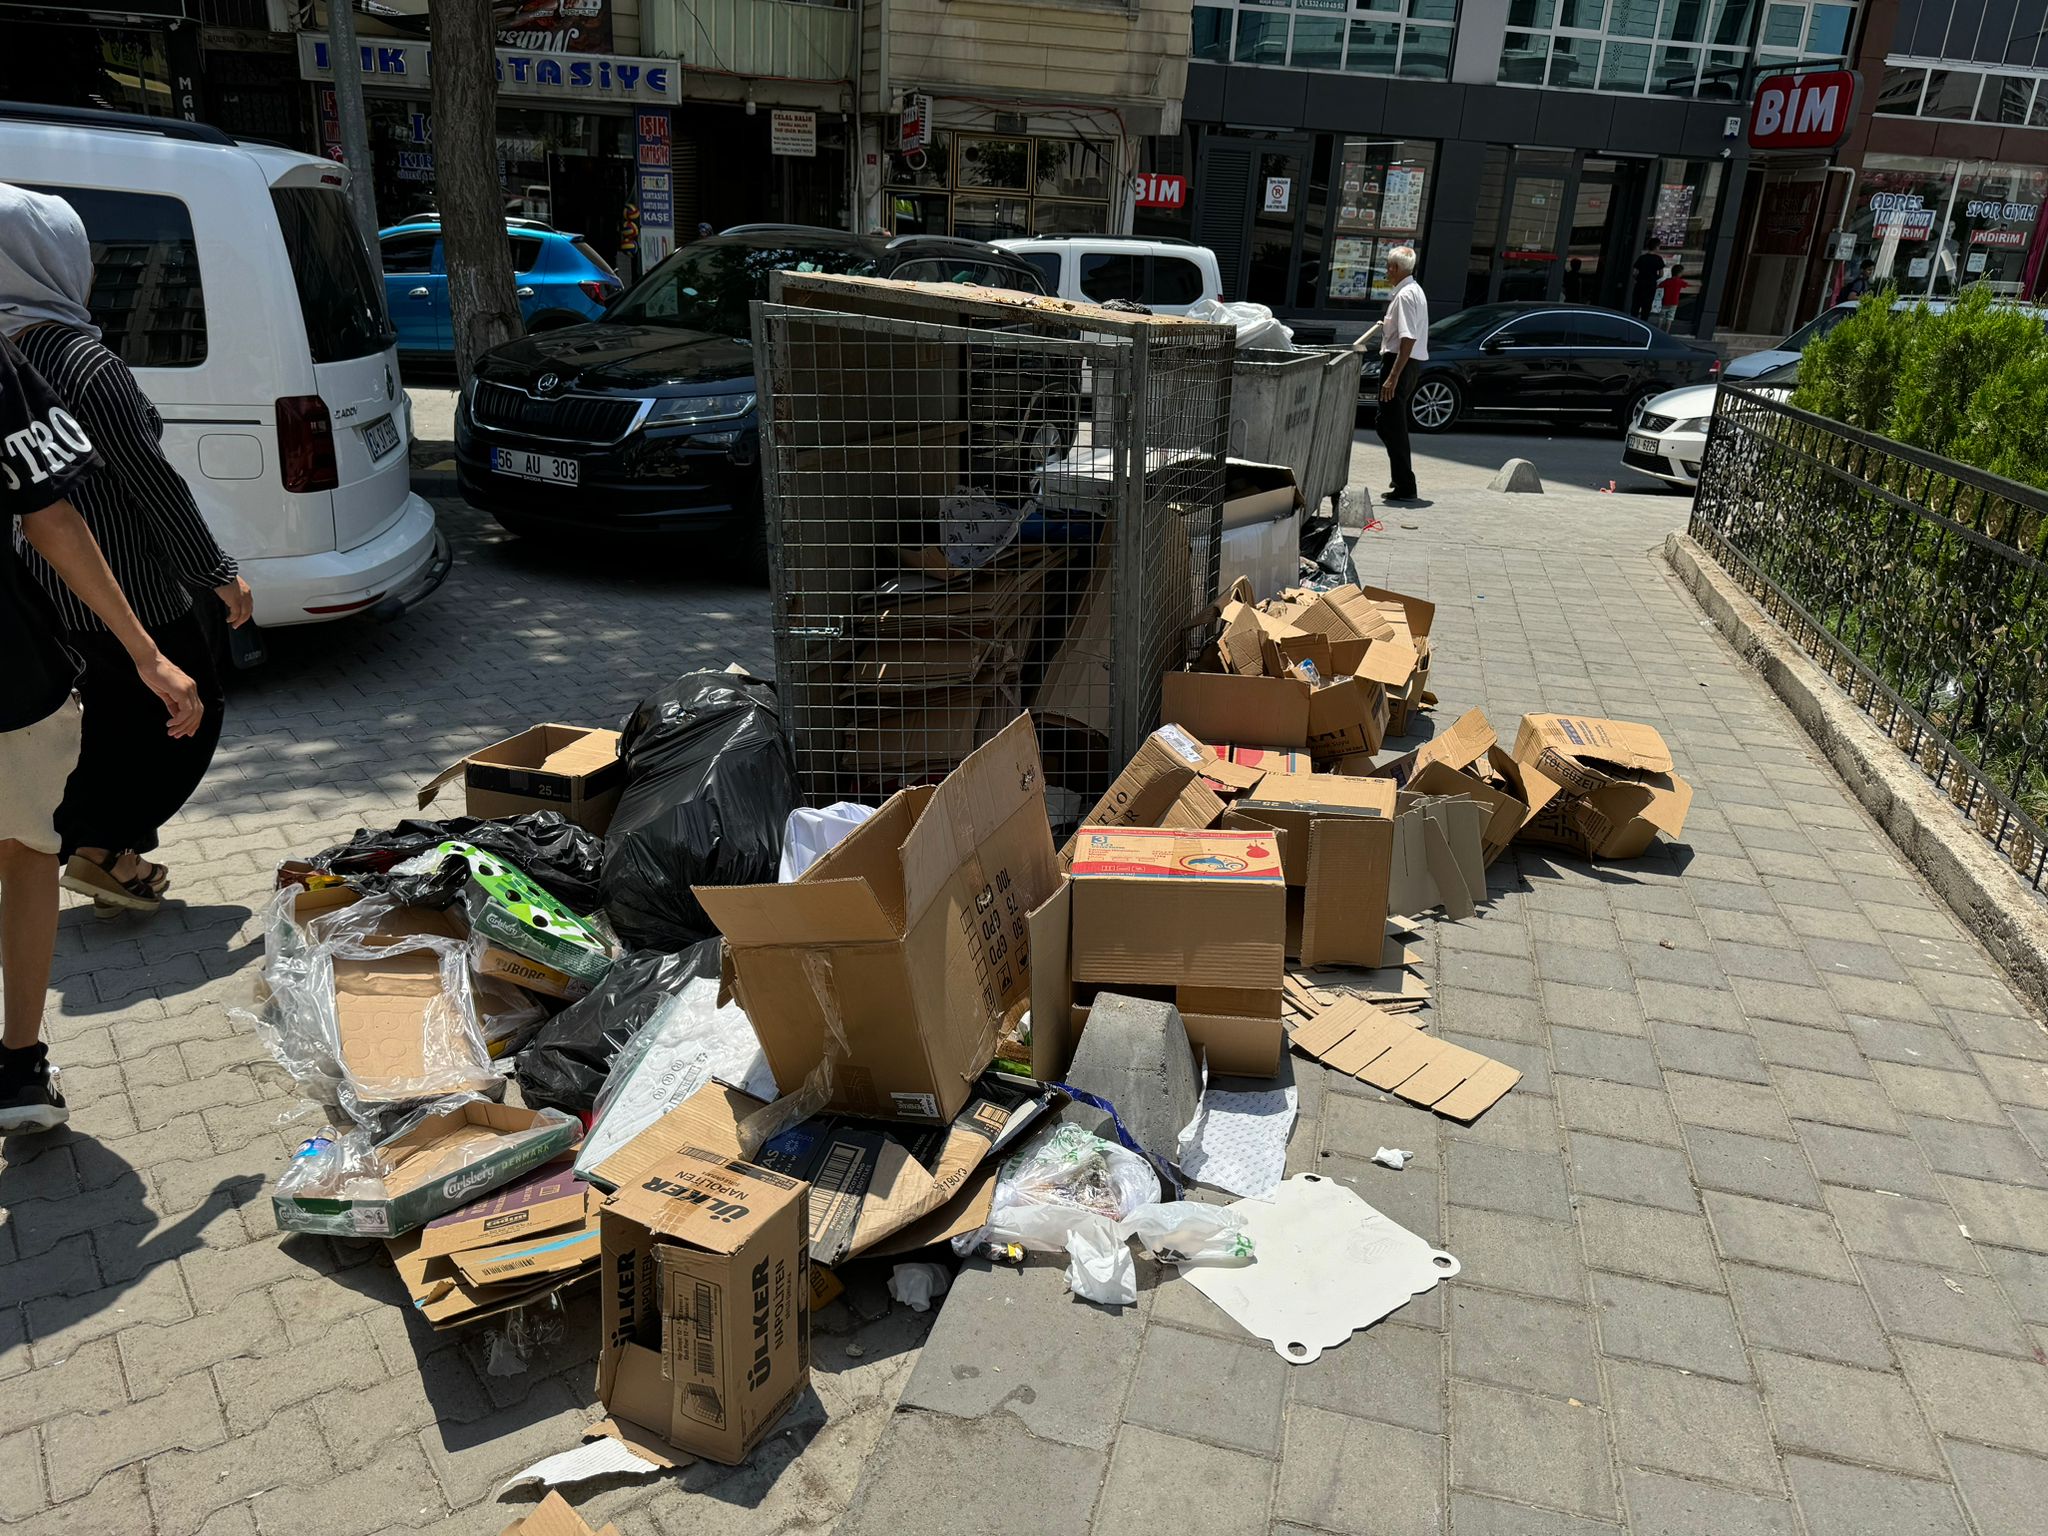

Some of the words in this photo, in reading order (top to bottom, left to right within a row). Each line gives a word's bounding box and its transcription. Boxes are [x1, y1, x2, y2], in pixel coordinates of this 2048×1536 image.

[315, 43, 407, 74] IIK
[1754, 74, 1839, 136] BİM
[1134, 173, 1180, 203] BİM
[1870, 192, 1925, 211] ADRES
[643, 211, 670, 223] KAŞE
[1966, 200, 2001, 220] SPOR
[498, 450, 512, 469] 56
[525, 455, 540, 474] AU
[552, 459, 577, 480] 303
[539, 784, 552, 795] 25
[995, 867, 1011, 893] 100
[1006, 892, 1018, 915] 75
[486, 913, 520, 936] Carlsberg
[1012, 917, 1024, 940] 50
[501, 1144, 549, 1169] DENMARK
[443, 1164, 495, 1199] Carlsberg
[674, 1170, 750, 1201] NAPOLİTEN
[641, 1176, 750, 1224] ÜLKER
[611, 1248, 638, 1349] ÜLKER
[774, 1258, 786, 1350] NAPOLİTEN
[747, 1255, 771, 1392] ÜLKER
